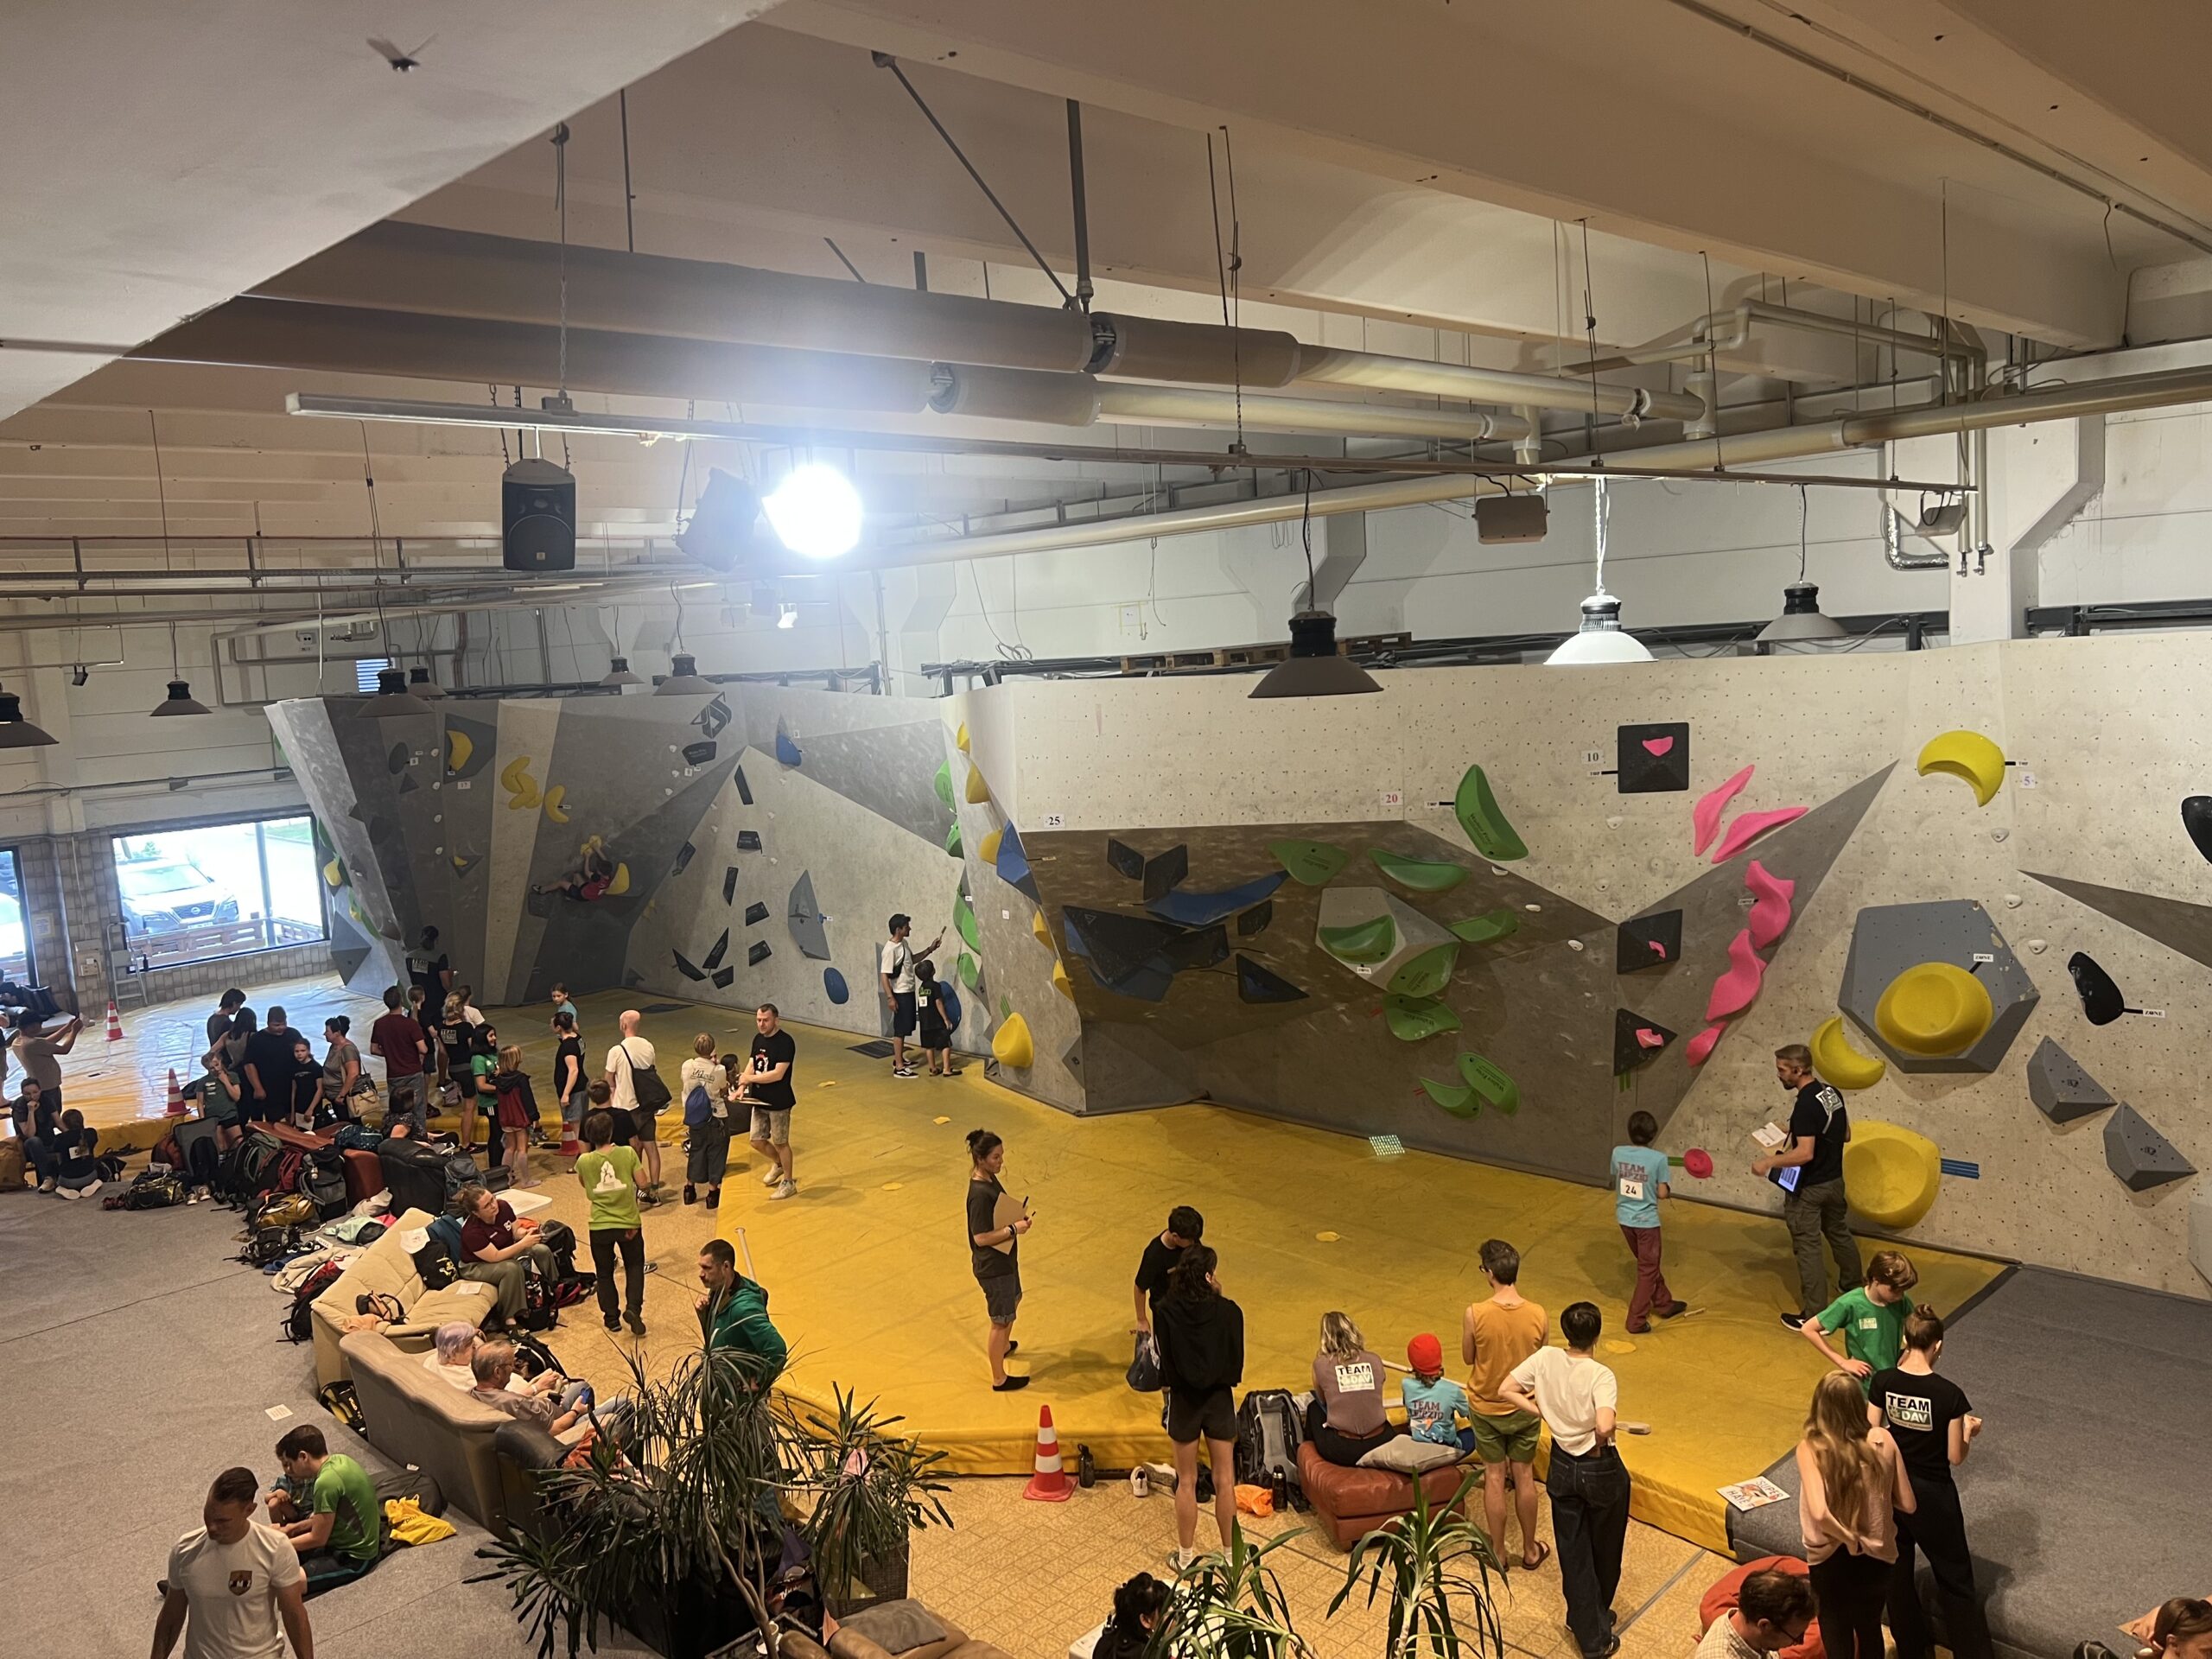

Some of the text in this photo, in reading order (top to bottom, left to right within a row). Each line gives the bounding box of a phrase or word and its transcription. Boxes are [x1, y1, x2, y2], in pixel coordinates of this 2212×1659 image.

[1587, 753, 1599, 762] 10
[2024, 776, 2031, 785] 5
[1385, 794, 1398, 804] 20
[1049, 816, 1060, 825] 25
[1618, 1161, 1645, 1173] TEAM
[1625, 1185, 1637, 1195] 24
[1338, 1365, 1371, 1376] TEAM
[1351, 1374, 1371, 1384] DAV
[1413, 1401, 1440, 1411] TEAM
[1887, 1395, 1929, 1412] TEAM
[1901, 1410, 1928, 1423] DAV
